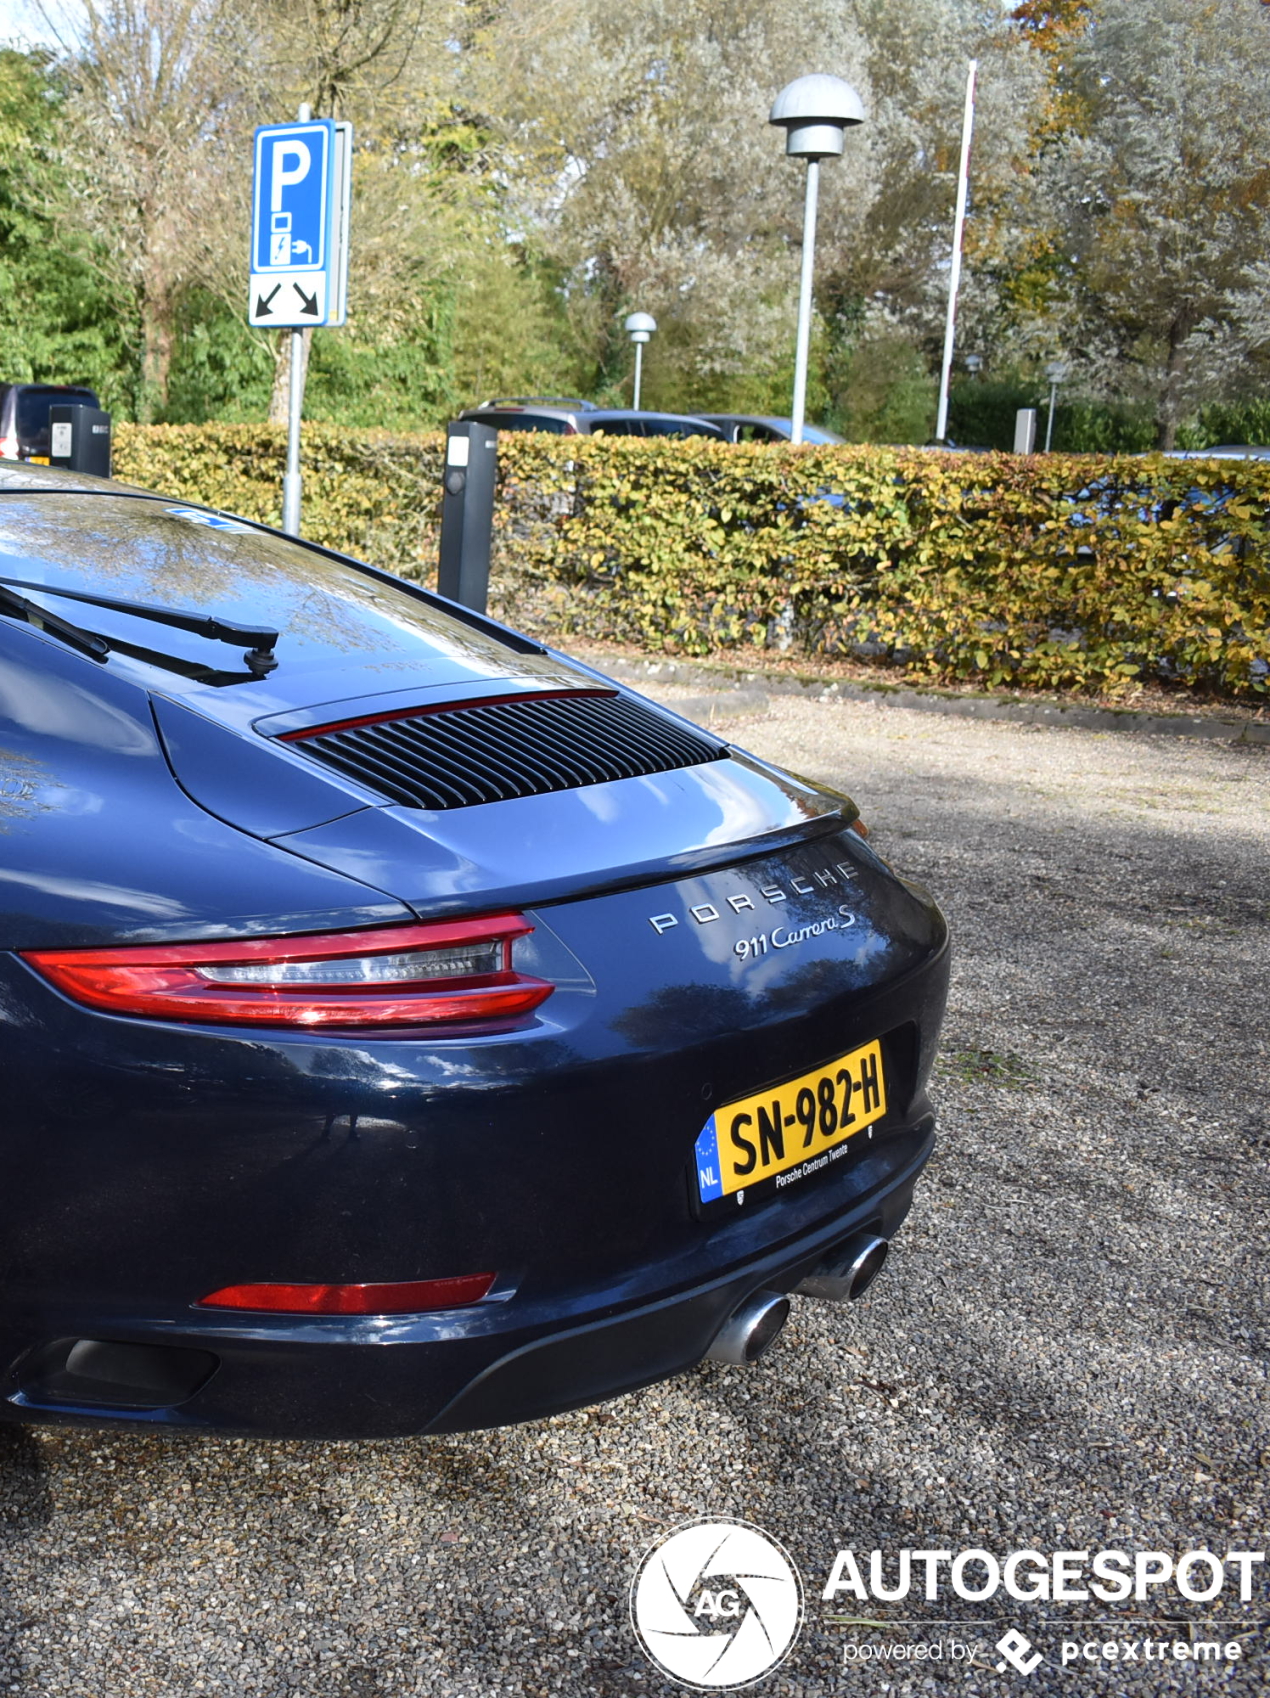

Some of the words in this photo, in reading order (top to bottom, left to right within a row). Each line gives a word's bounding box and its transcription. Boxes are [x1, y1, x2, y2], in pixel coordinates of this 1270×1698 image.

[270, 139, 312, 212] P
[648, 861, 859, 936] PORSCHE
[733, 933, 768, 961] 911
[771, 916, 839, 949] Carrera
[838, 904, 856, 929] S
[730, 1053, 881, 1176] SN-982-H
[700, 1167, 719, 1189] NL
[776, 1168, 802, 1189] Porsche
[802, 1154, 829, 1176] Centrum
[828, 1143, 848, 1164] Twente
